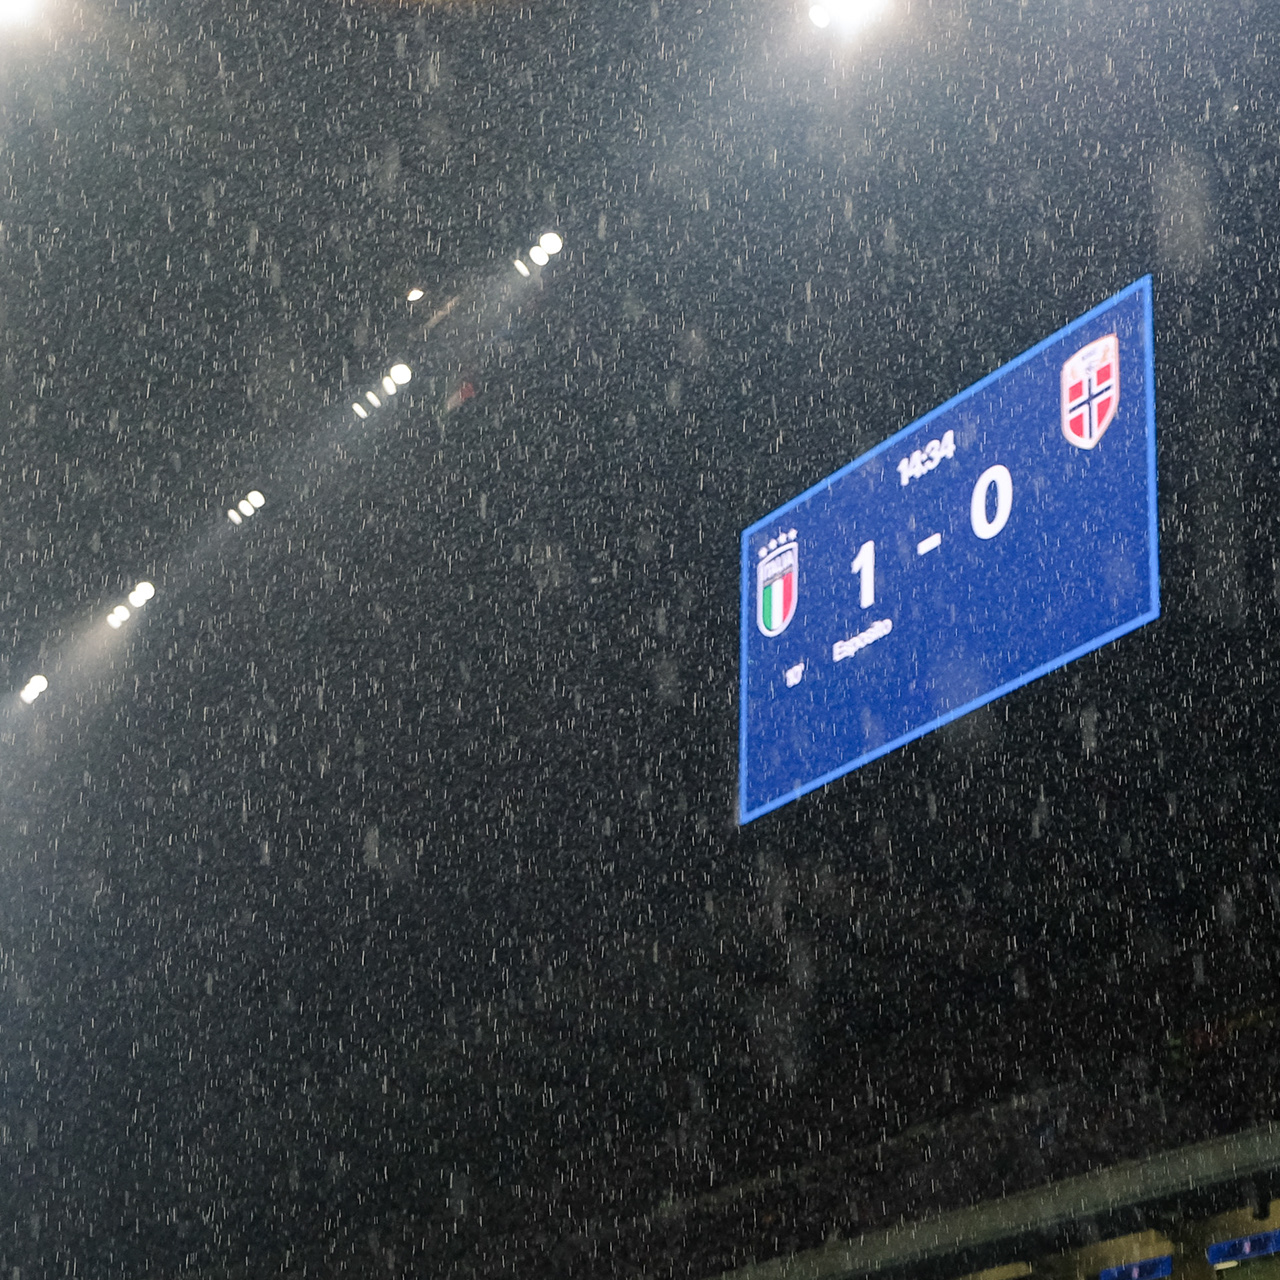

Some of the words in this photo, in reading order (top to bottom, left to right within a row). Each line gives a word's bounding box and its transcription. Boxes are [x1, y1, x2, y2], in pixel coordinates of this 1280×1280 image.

[896, 429, 956, 486] 14:34
[851, 540, 875, 609] 1
[970, 464, 1013, 540] 0
